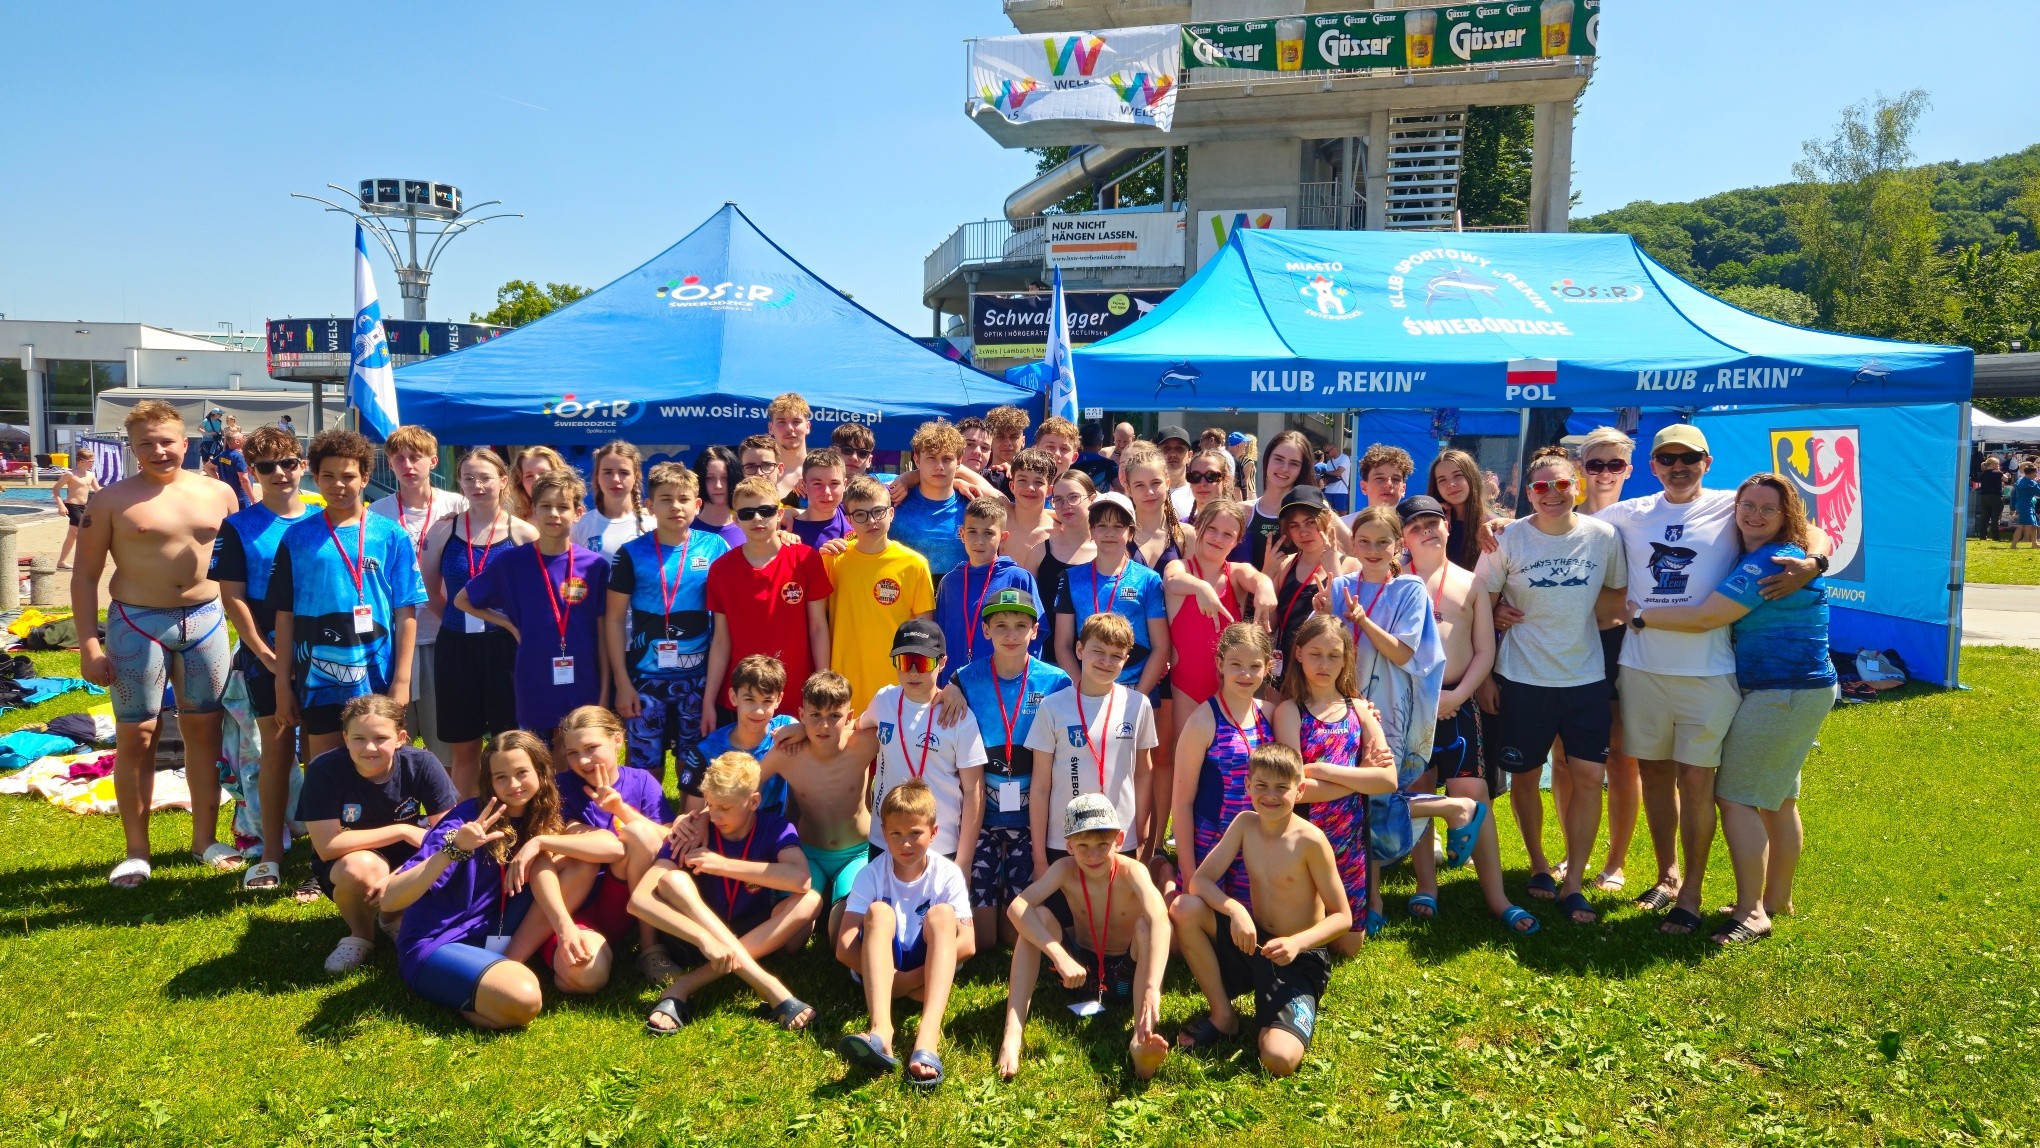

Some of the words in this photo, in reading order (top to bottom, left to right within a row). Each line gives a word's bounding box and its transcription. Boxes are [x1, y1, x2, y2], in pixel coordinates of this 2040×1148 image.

[1315, 17, 1338, 28] Gösser
[1343, 15, 1367, 26] Gösser
[1372, 13, 1396, 25] Gösser
[1446, 9, 1470, 20] Gösser
[1476, 7, 1500, 18] Gösser
[1507, 4, 1531, 16] Gösser
[1217, 24, 1239, 34] Gösser
[1245, 22, 1267, 32] Gösser
[1193, 38, 1263, 64] Gösser
[1318, 29, 1391, 66] Gösser
[1449, 22, 1526, 61] Gösser
[1054, 79, 1090, 90] WELS
[1120, 104, 1155, 118] WELS
[1052, 222, 1073, 230] NUR
[1077, 221, 1106, 229] NICHT
[1052, 231, 1095, 241] HÄNGEN
[1098, 231, 1138, 240] LASSEN.
[1285, 262, 1343, 271] MIASTO
[1394, 248, 1493, 274] SPORTOWY
[1388, 274, 1407, 308] KLUB
[984, 309, 1108, 328] Schwabgger
[1402, 316, 1575, 336] ŚWIEBODZICE
[329, 320, 338, 351] WELS
[449, 324, 459, 351] WELS
[1008, 329, 1047, 337] HÖRGERÄTE
[1251, 370, 1315, 392] KLUB
[1636, 369, 1697, 391] KLUB
[1505, 385, 1557, 401] POL
[660, 403, 883, 424] www.osir.swodzice.pl
[1070, 756, 1080, 799] ŚWIEBO
